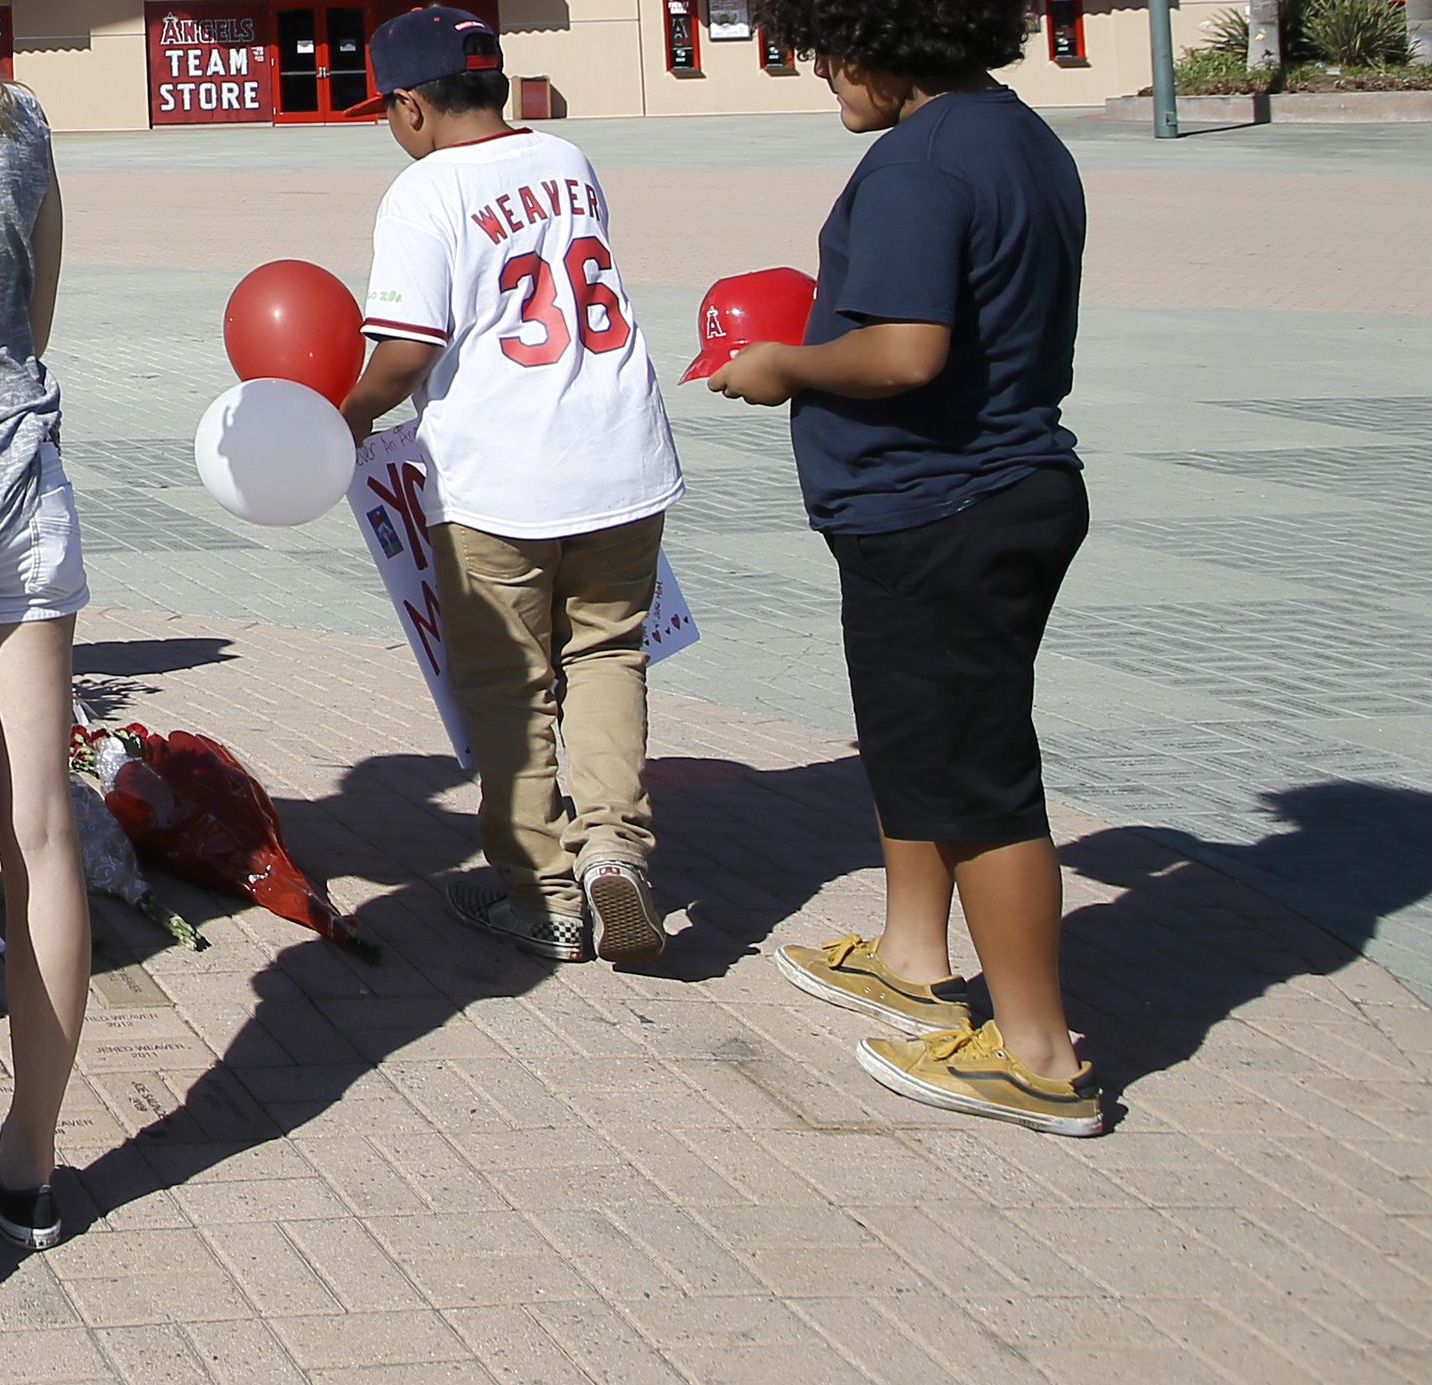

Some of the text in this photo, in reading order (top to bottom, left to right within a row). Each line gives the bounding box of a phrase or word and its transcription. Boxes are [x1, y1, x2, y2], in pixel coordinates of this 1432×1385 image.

[160, 12, 255, 45] ANGELS
[165, 47, 249, 77] TEAM
[159, 80, 260, 112] STORE
[471, 178, 600, 246] WEAVER
[499, 236, 631, 368] 36
[109, 1013, 158, 1022] WEAVER
[134, 1043, 186, 1053] WEAVER
